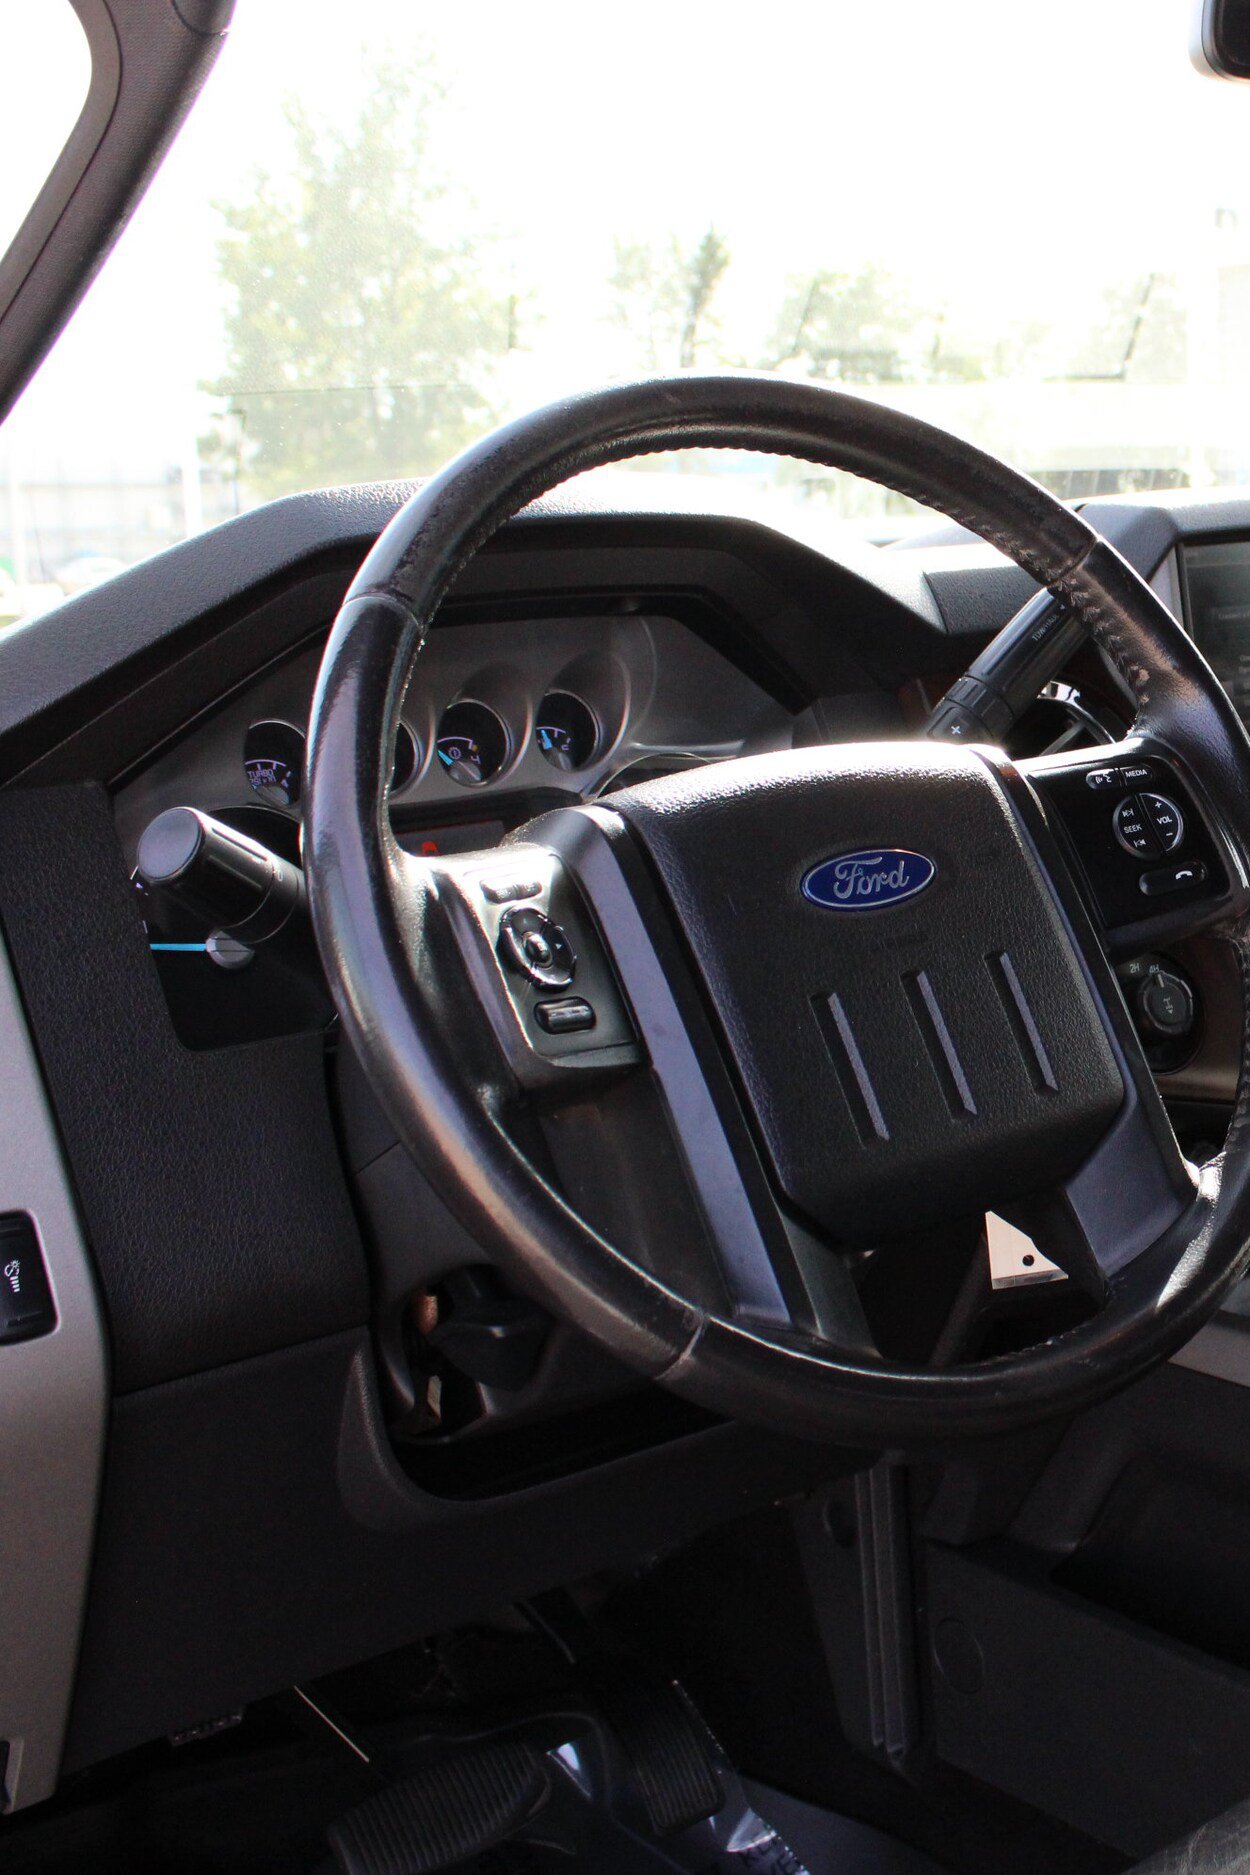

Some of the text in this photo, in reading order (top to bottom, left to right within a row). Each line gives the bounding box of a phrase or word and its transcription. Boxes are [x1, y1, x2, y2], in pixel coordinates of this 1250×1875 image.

[1125, 769, 1148, 778] MEDIA
[1157, 816, 1172, 825] VOL
[1124, 824, 1142, 833] SEEK
[833, 856, 909, 899] Ford
[1129, 962, 1140, 974] 2H
